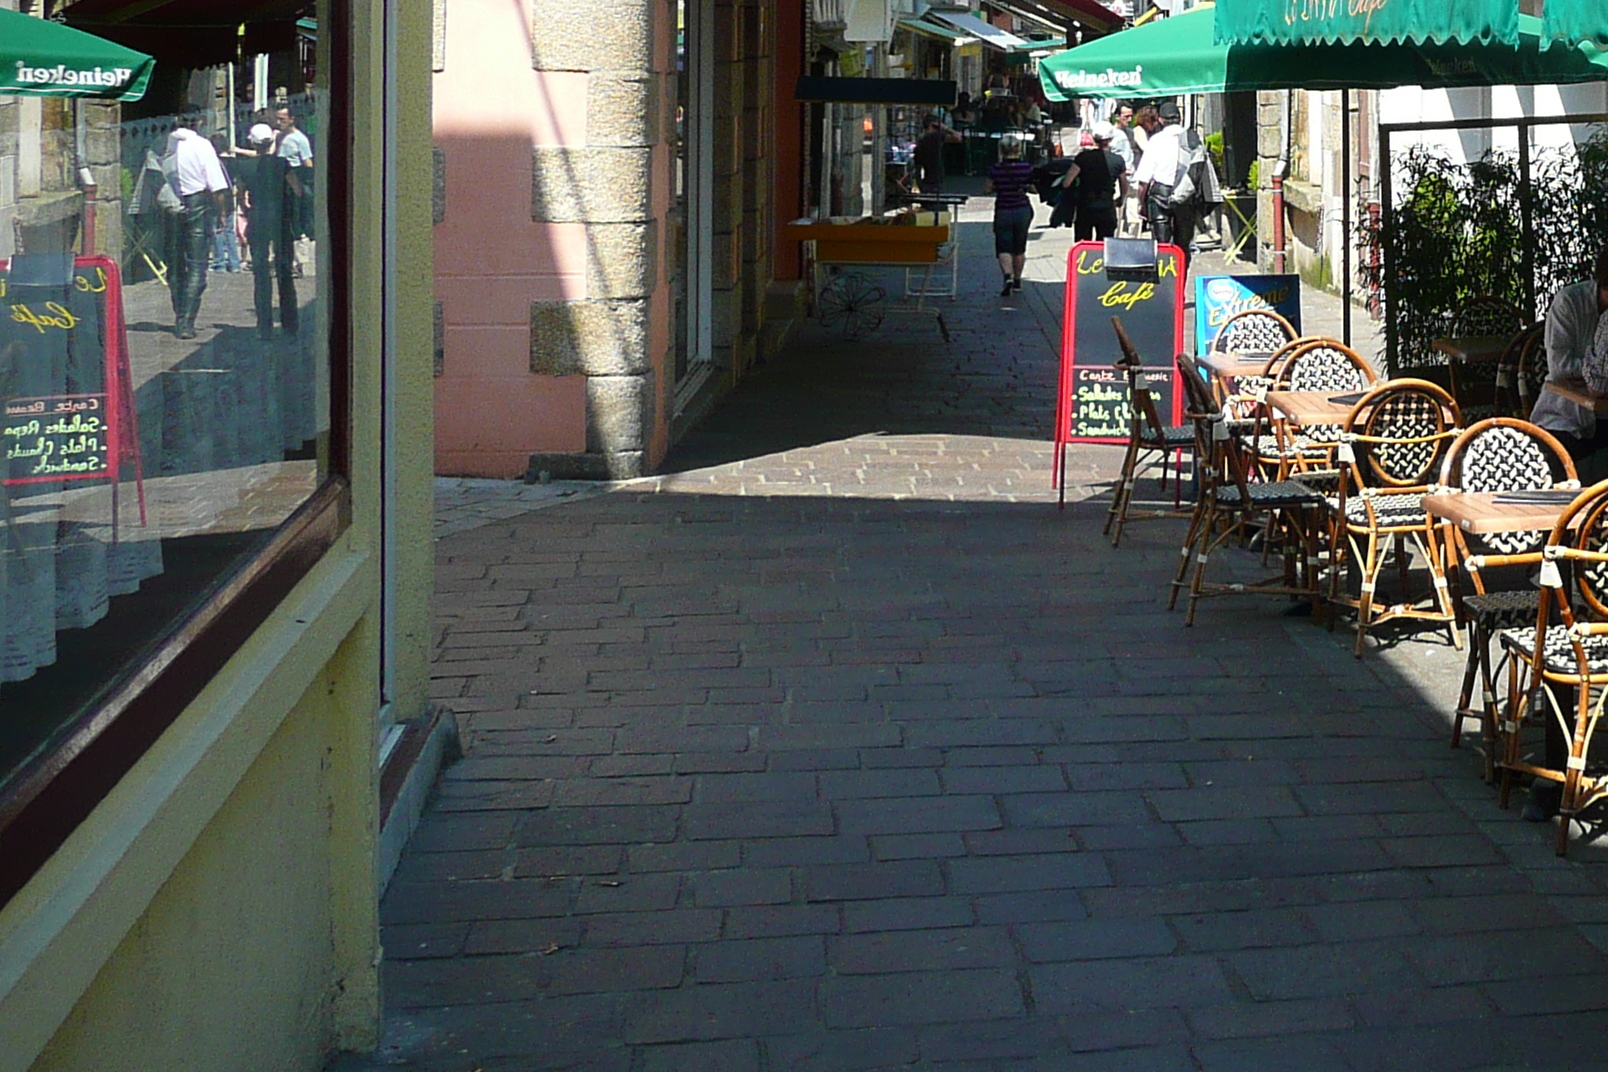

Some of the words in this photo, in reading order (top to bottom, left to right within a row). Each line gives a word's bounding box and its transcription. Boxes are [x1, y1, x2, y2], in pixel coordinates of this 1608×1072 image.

[1054, 67, 1142, 88] Heineken
[1076, 250, 1103, 275] Le
[1097, 280, 1155, 310] Café
[1078, 383, 1122, 401] Salades
[1079, 402, 1110, 420] Plats
